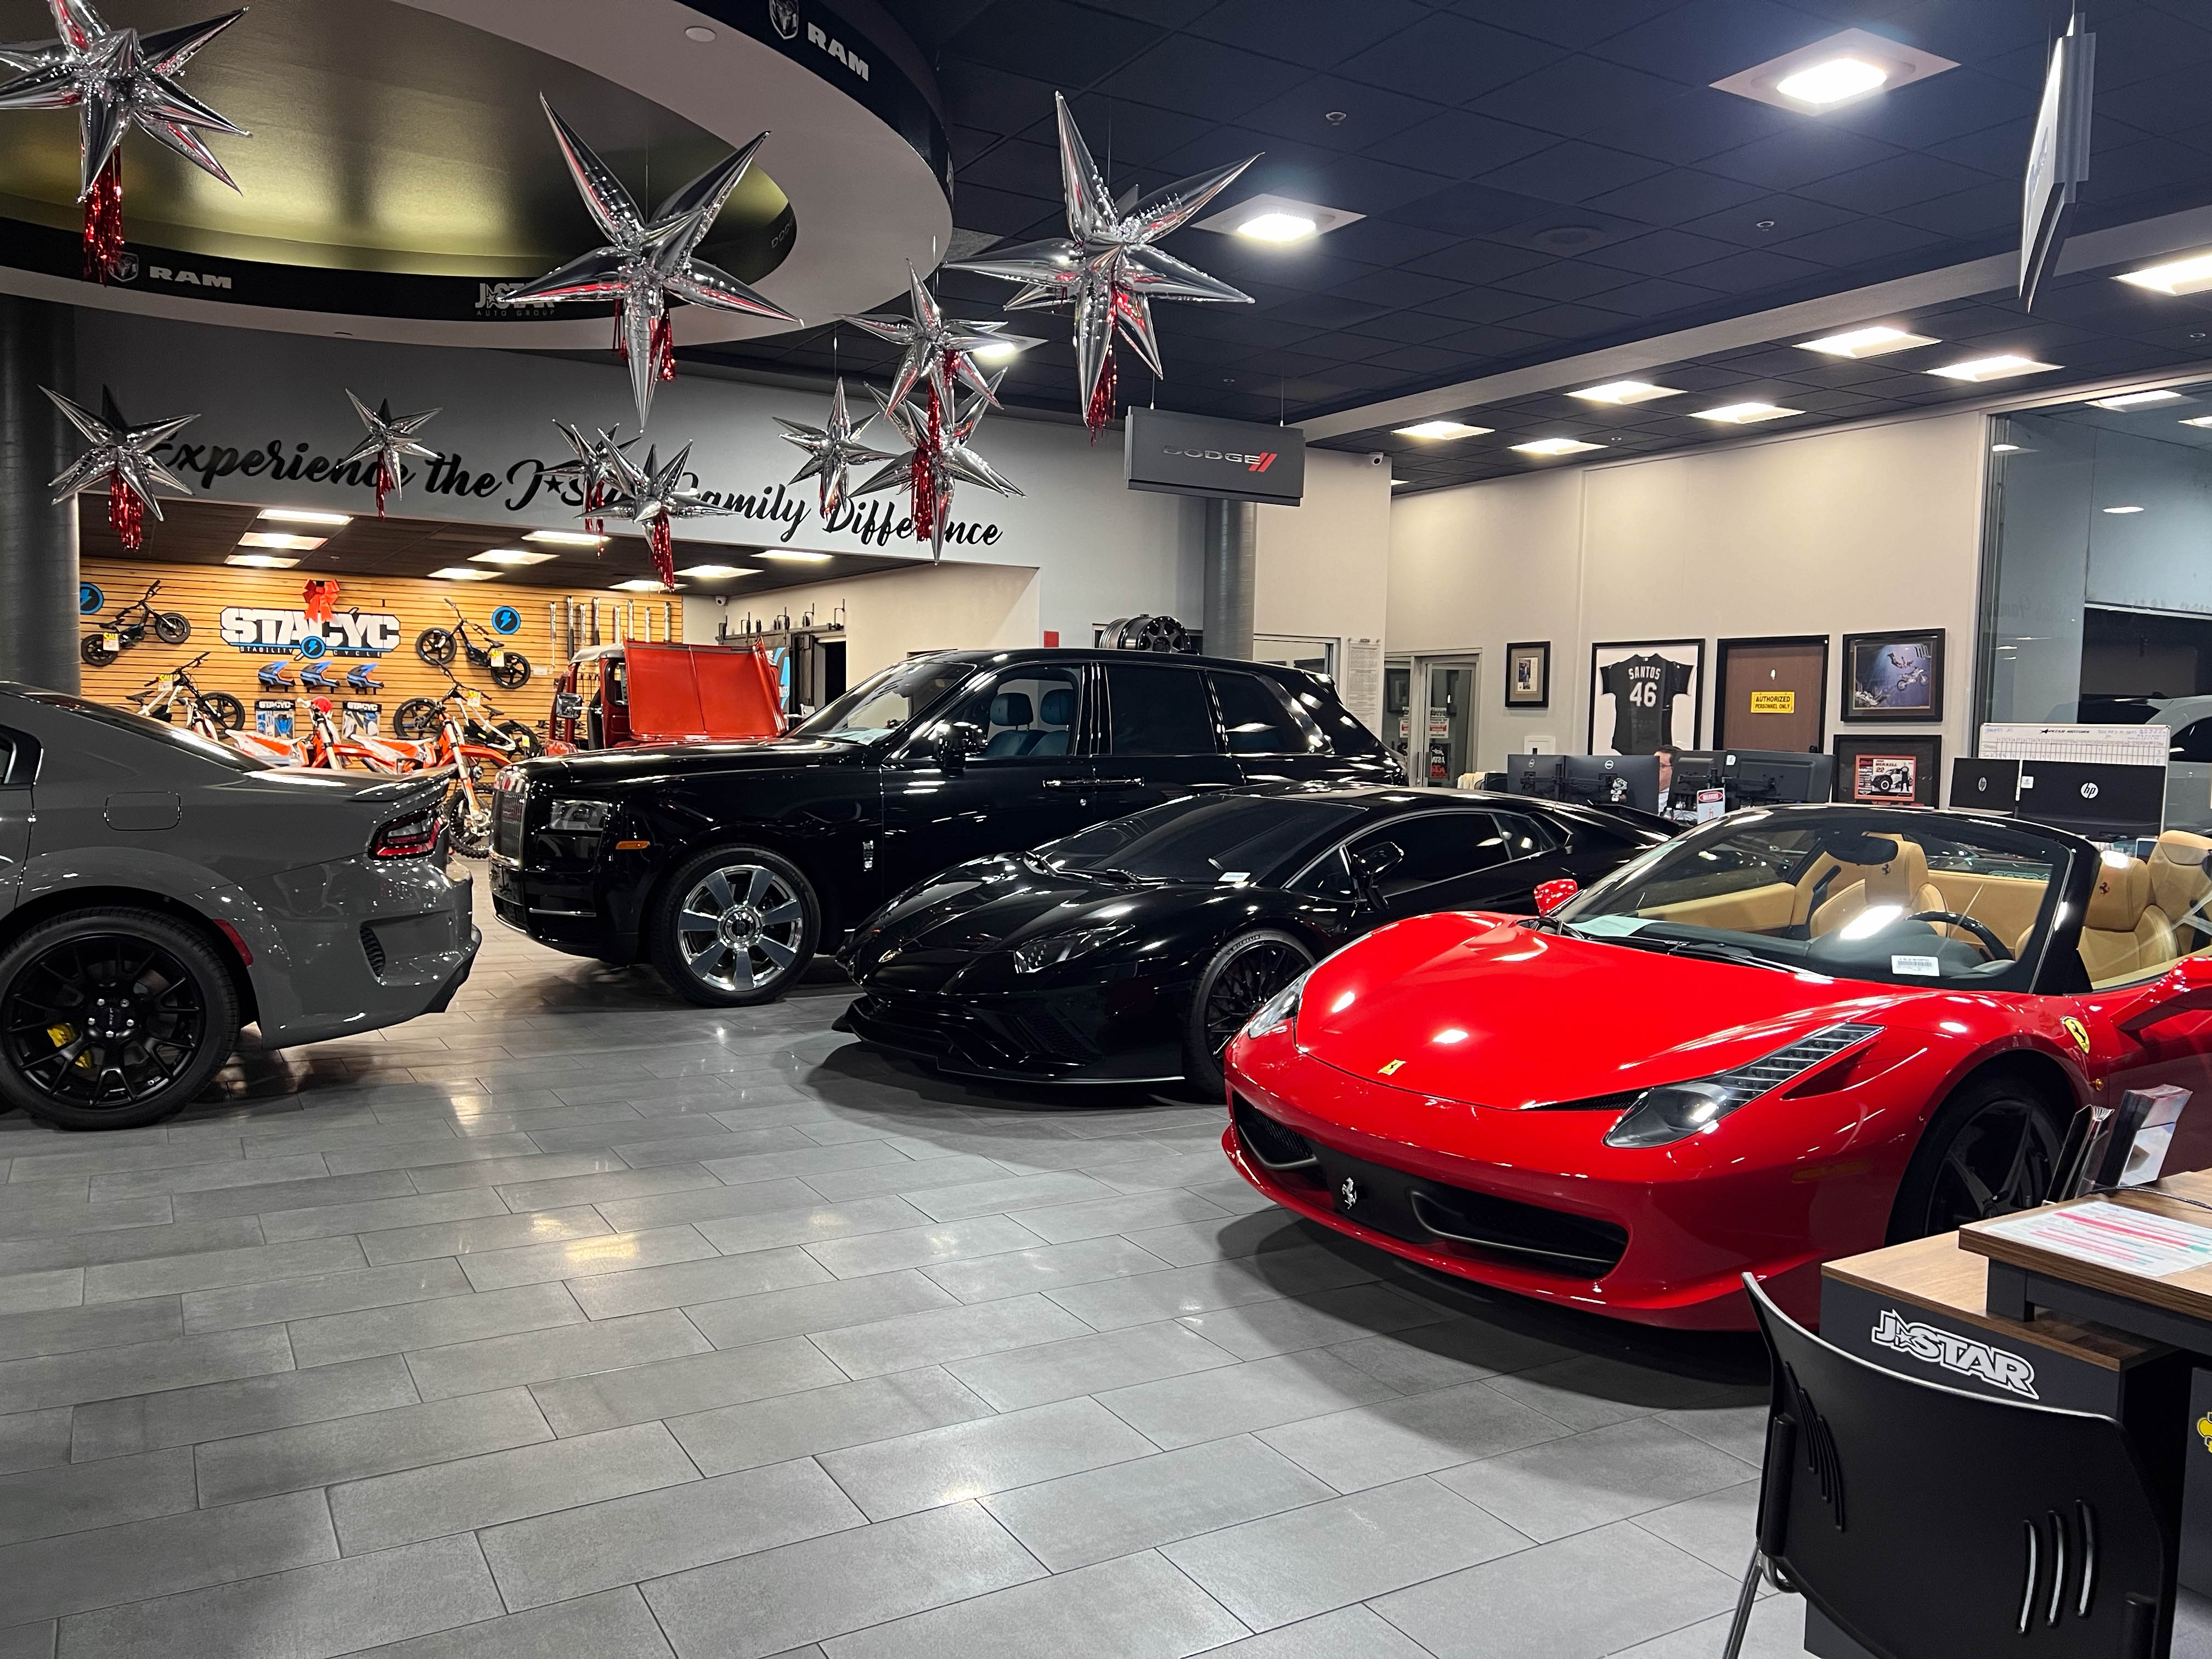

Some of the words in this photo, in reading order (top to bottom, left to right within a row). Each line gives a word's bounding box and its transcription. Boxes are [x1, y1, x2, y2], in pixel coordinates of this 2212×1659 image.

[808, 21, 869, 82] RAM
[149, 266, 232, 289] RAM
[1163, 445, 1261, 465] DODGE
[424, 452, 503, 498] the
[680, 472, 811, 543] amily
[820, 496, 1003, 547] Diffence
[221, 606, 401, 650] STACYC
[240, 646, 294, 654] STABILITY
[1628, 665, 1661, 680] SANTOS
[1629, 681, 1657, 707] 46
[2082, 782, 2097, 798] hp
